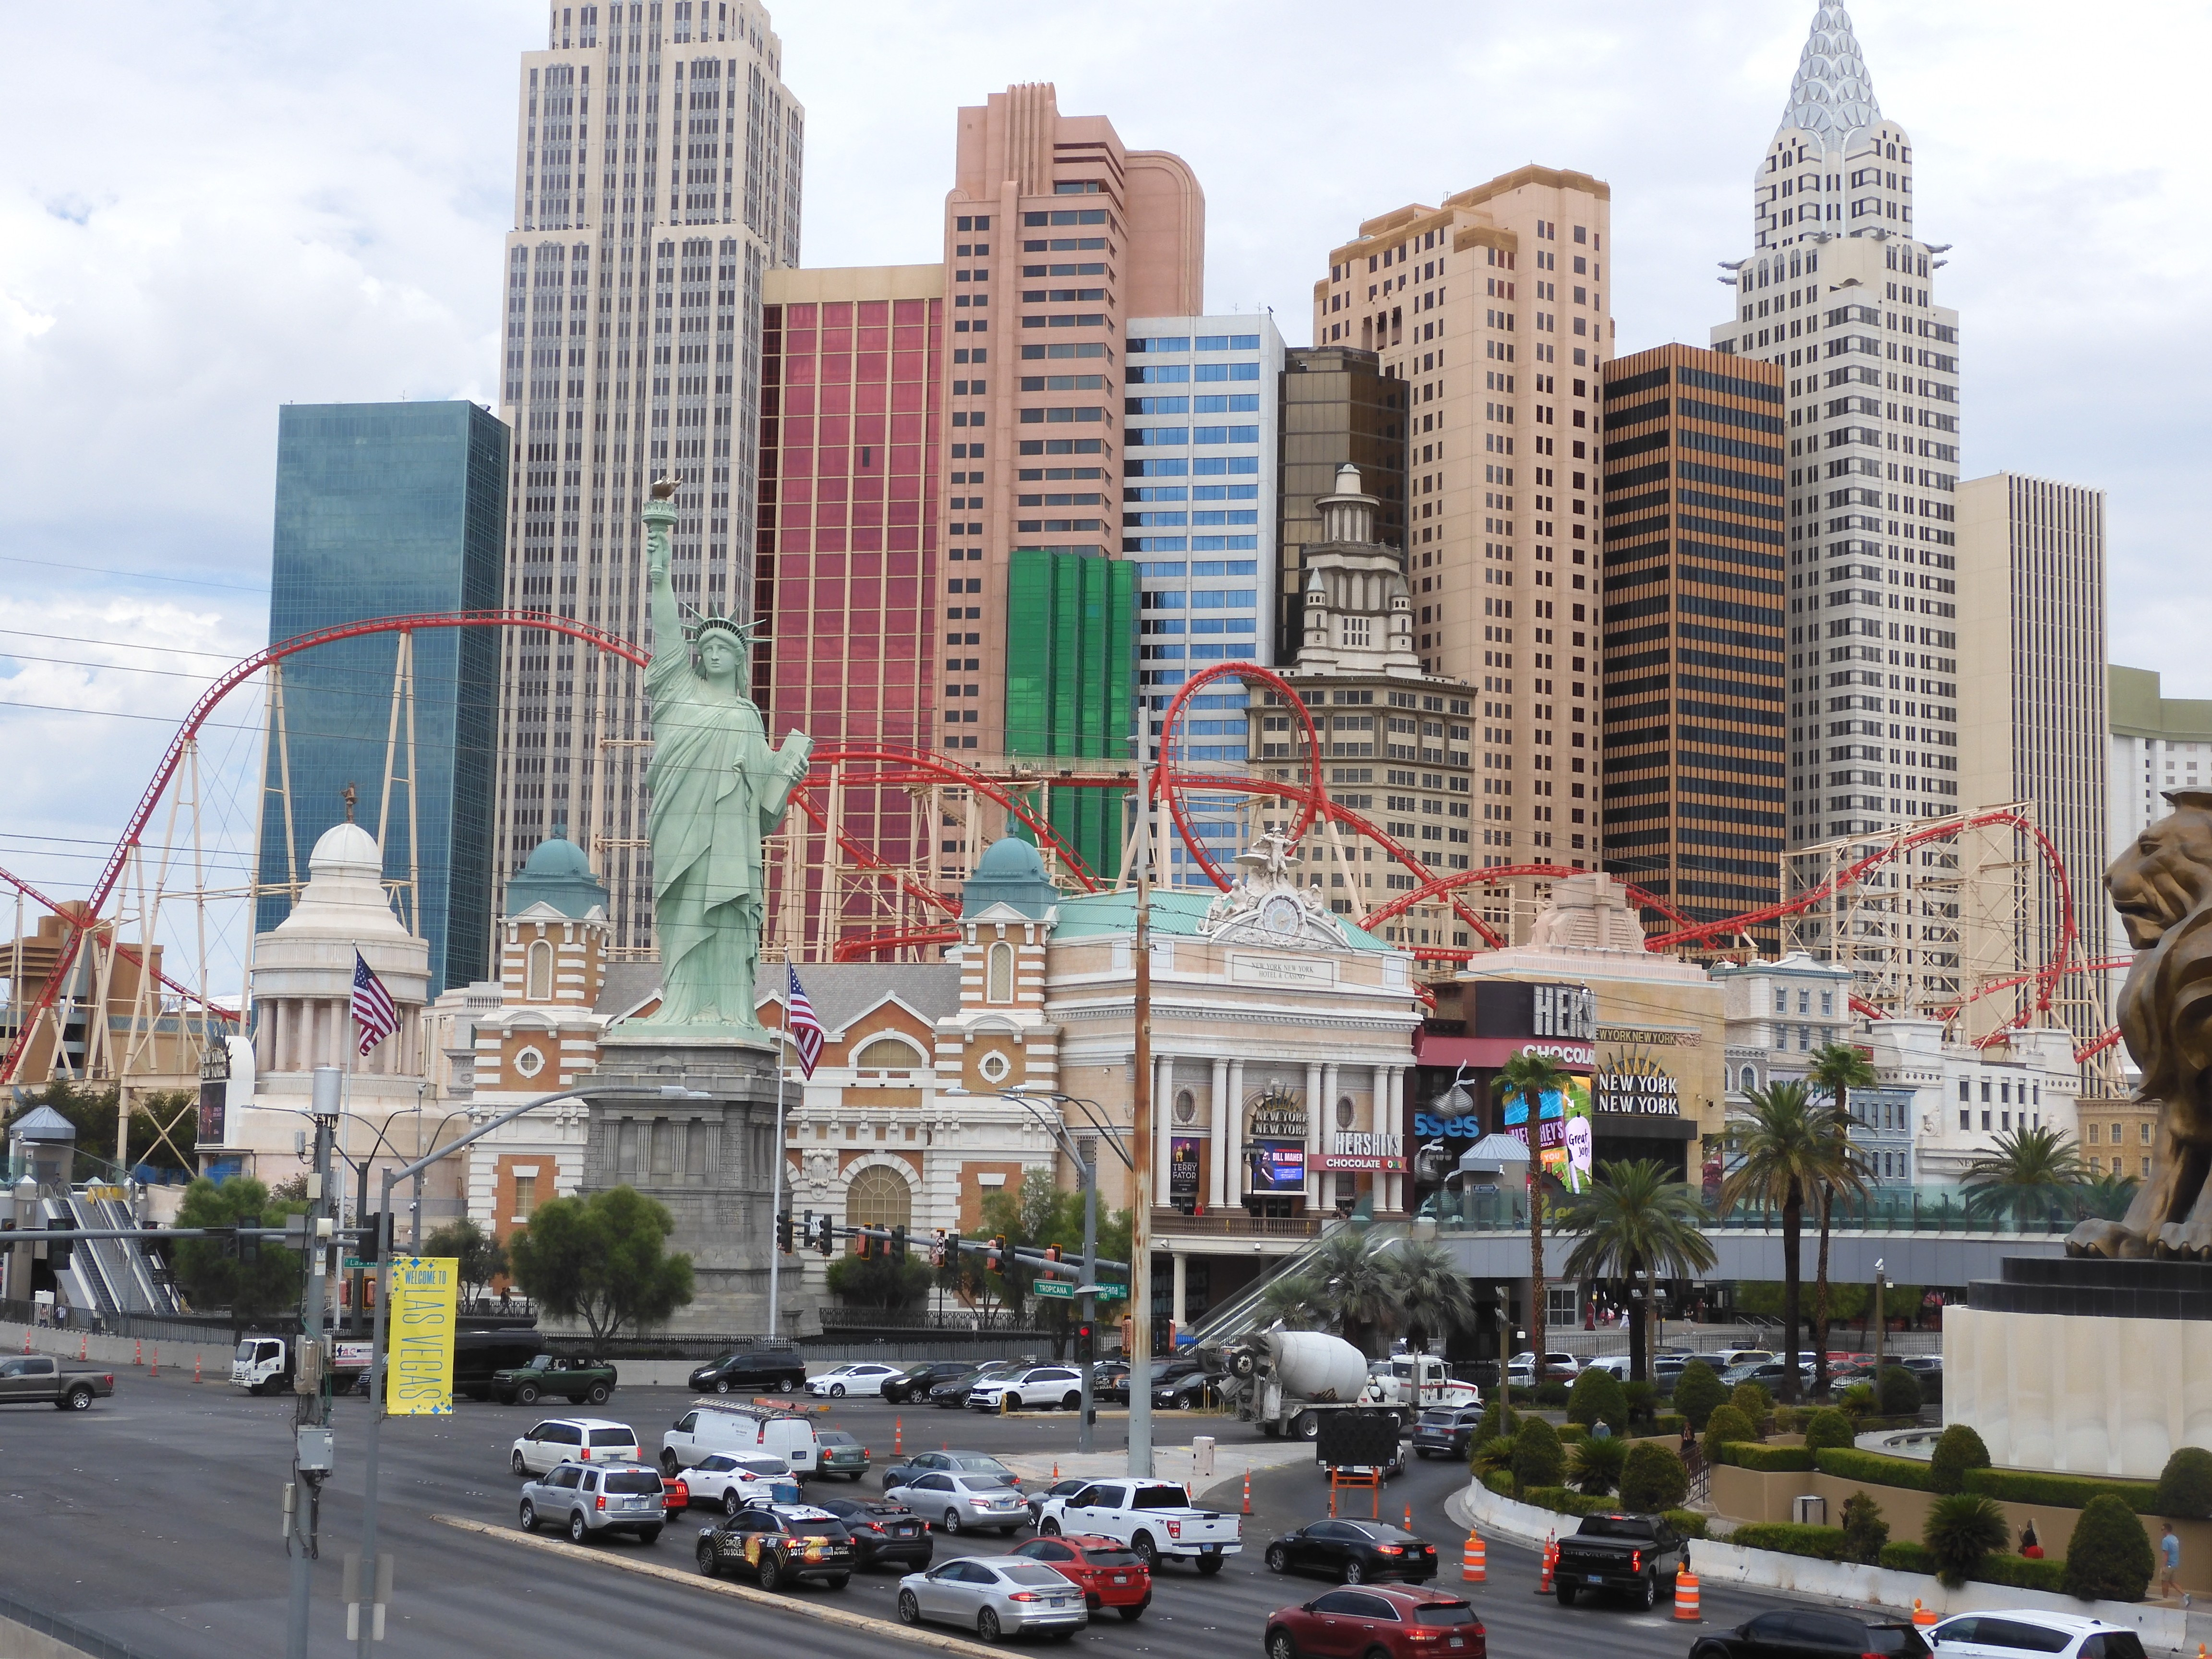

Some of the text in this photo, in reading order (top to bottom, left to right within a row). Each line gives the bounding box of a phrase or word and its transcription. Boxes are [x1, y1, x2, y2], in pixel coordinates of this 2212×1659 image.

[1599, 1073, 1677, 1094] NEW YORK
[1599, 1094, 1679, 1115] NEW YORK
[1256, 1110, 1309, 1122] NEW YORK
[1255, 1123, 1309, 1135] NEW YORK
[1509, 1121, 1564, 1145] HEHEY'S
[1569, 1129, 1588, 1146] Great
[1273, 1153, 1303, 1162] BILL MAHER
[1544, 1152, 1560, 1161] YOU
[1173, 1163, 1197, 1171] TERRY
[1326, 1158, 1403, 1169] CHOCOLATE WORLD
[1173, 1171, 1196, 1179] FATOR
[405, 1270, 446, 1285] WELCOME TO
[1039, 1285, 1068, 1295] TROPICANA
[398, 1290, 445, 1399] LAS VEGAS
[725, 1538, 742, 1549] CIRQUE
[731, 1549, 745, 1557] SOLEIL
[791, 1548, 804, 1556] 5013
